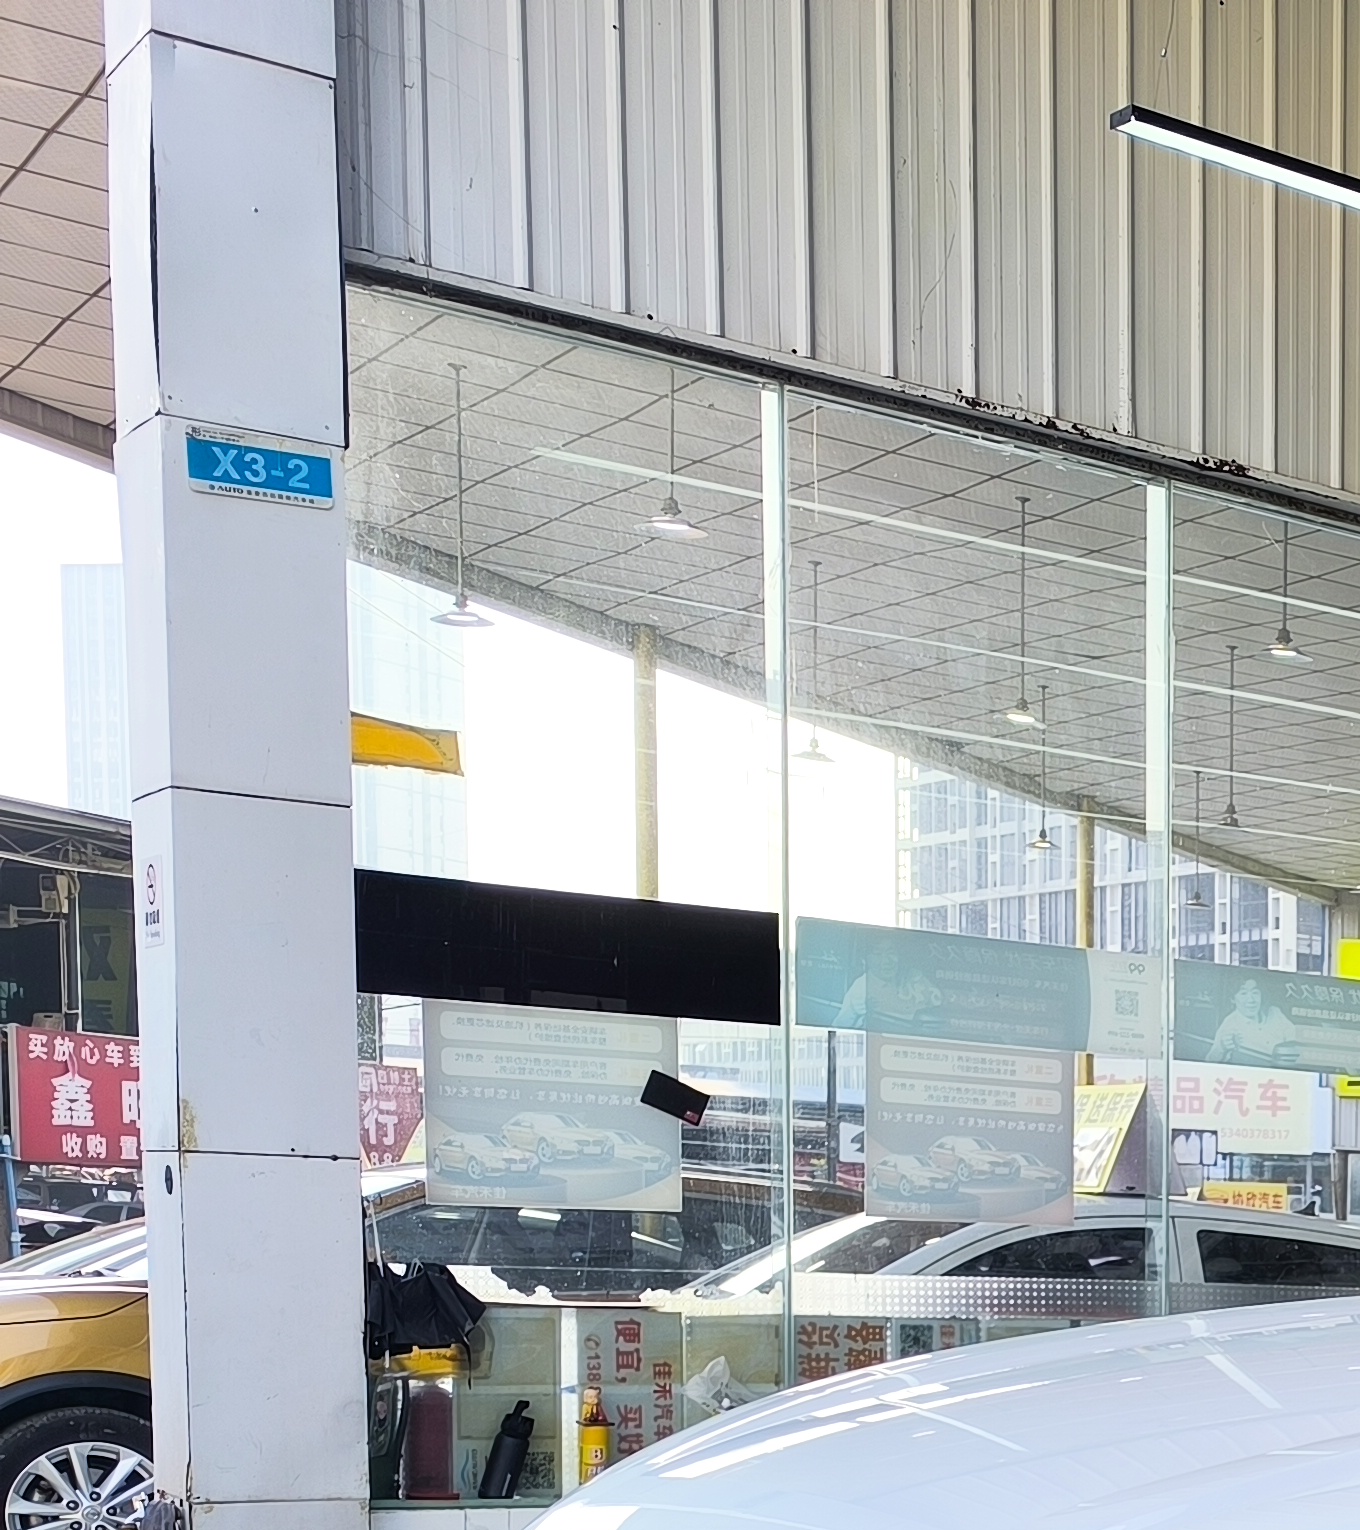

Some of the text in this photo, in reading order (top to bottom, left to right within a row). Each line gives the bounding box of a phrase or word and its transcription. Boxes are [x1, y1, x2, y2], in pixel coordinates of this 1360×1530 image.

[211, 446, 310, 489] X3-2
[62, 1133, 107, 1158] 收购
[652, 1361, 675, 1442] 佳禾汽车
